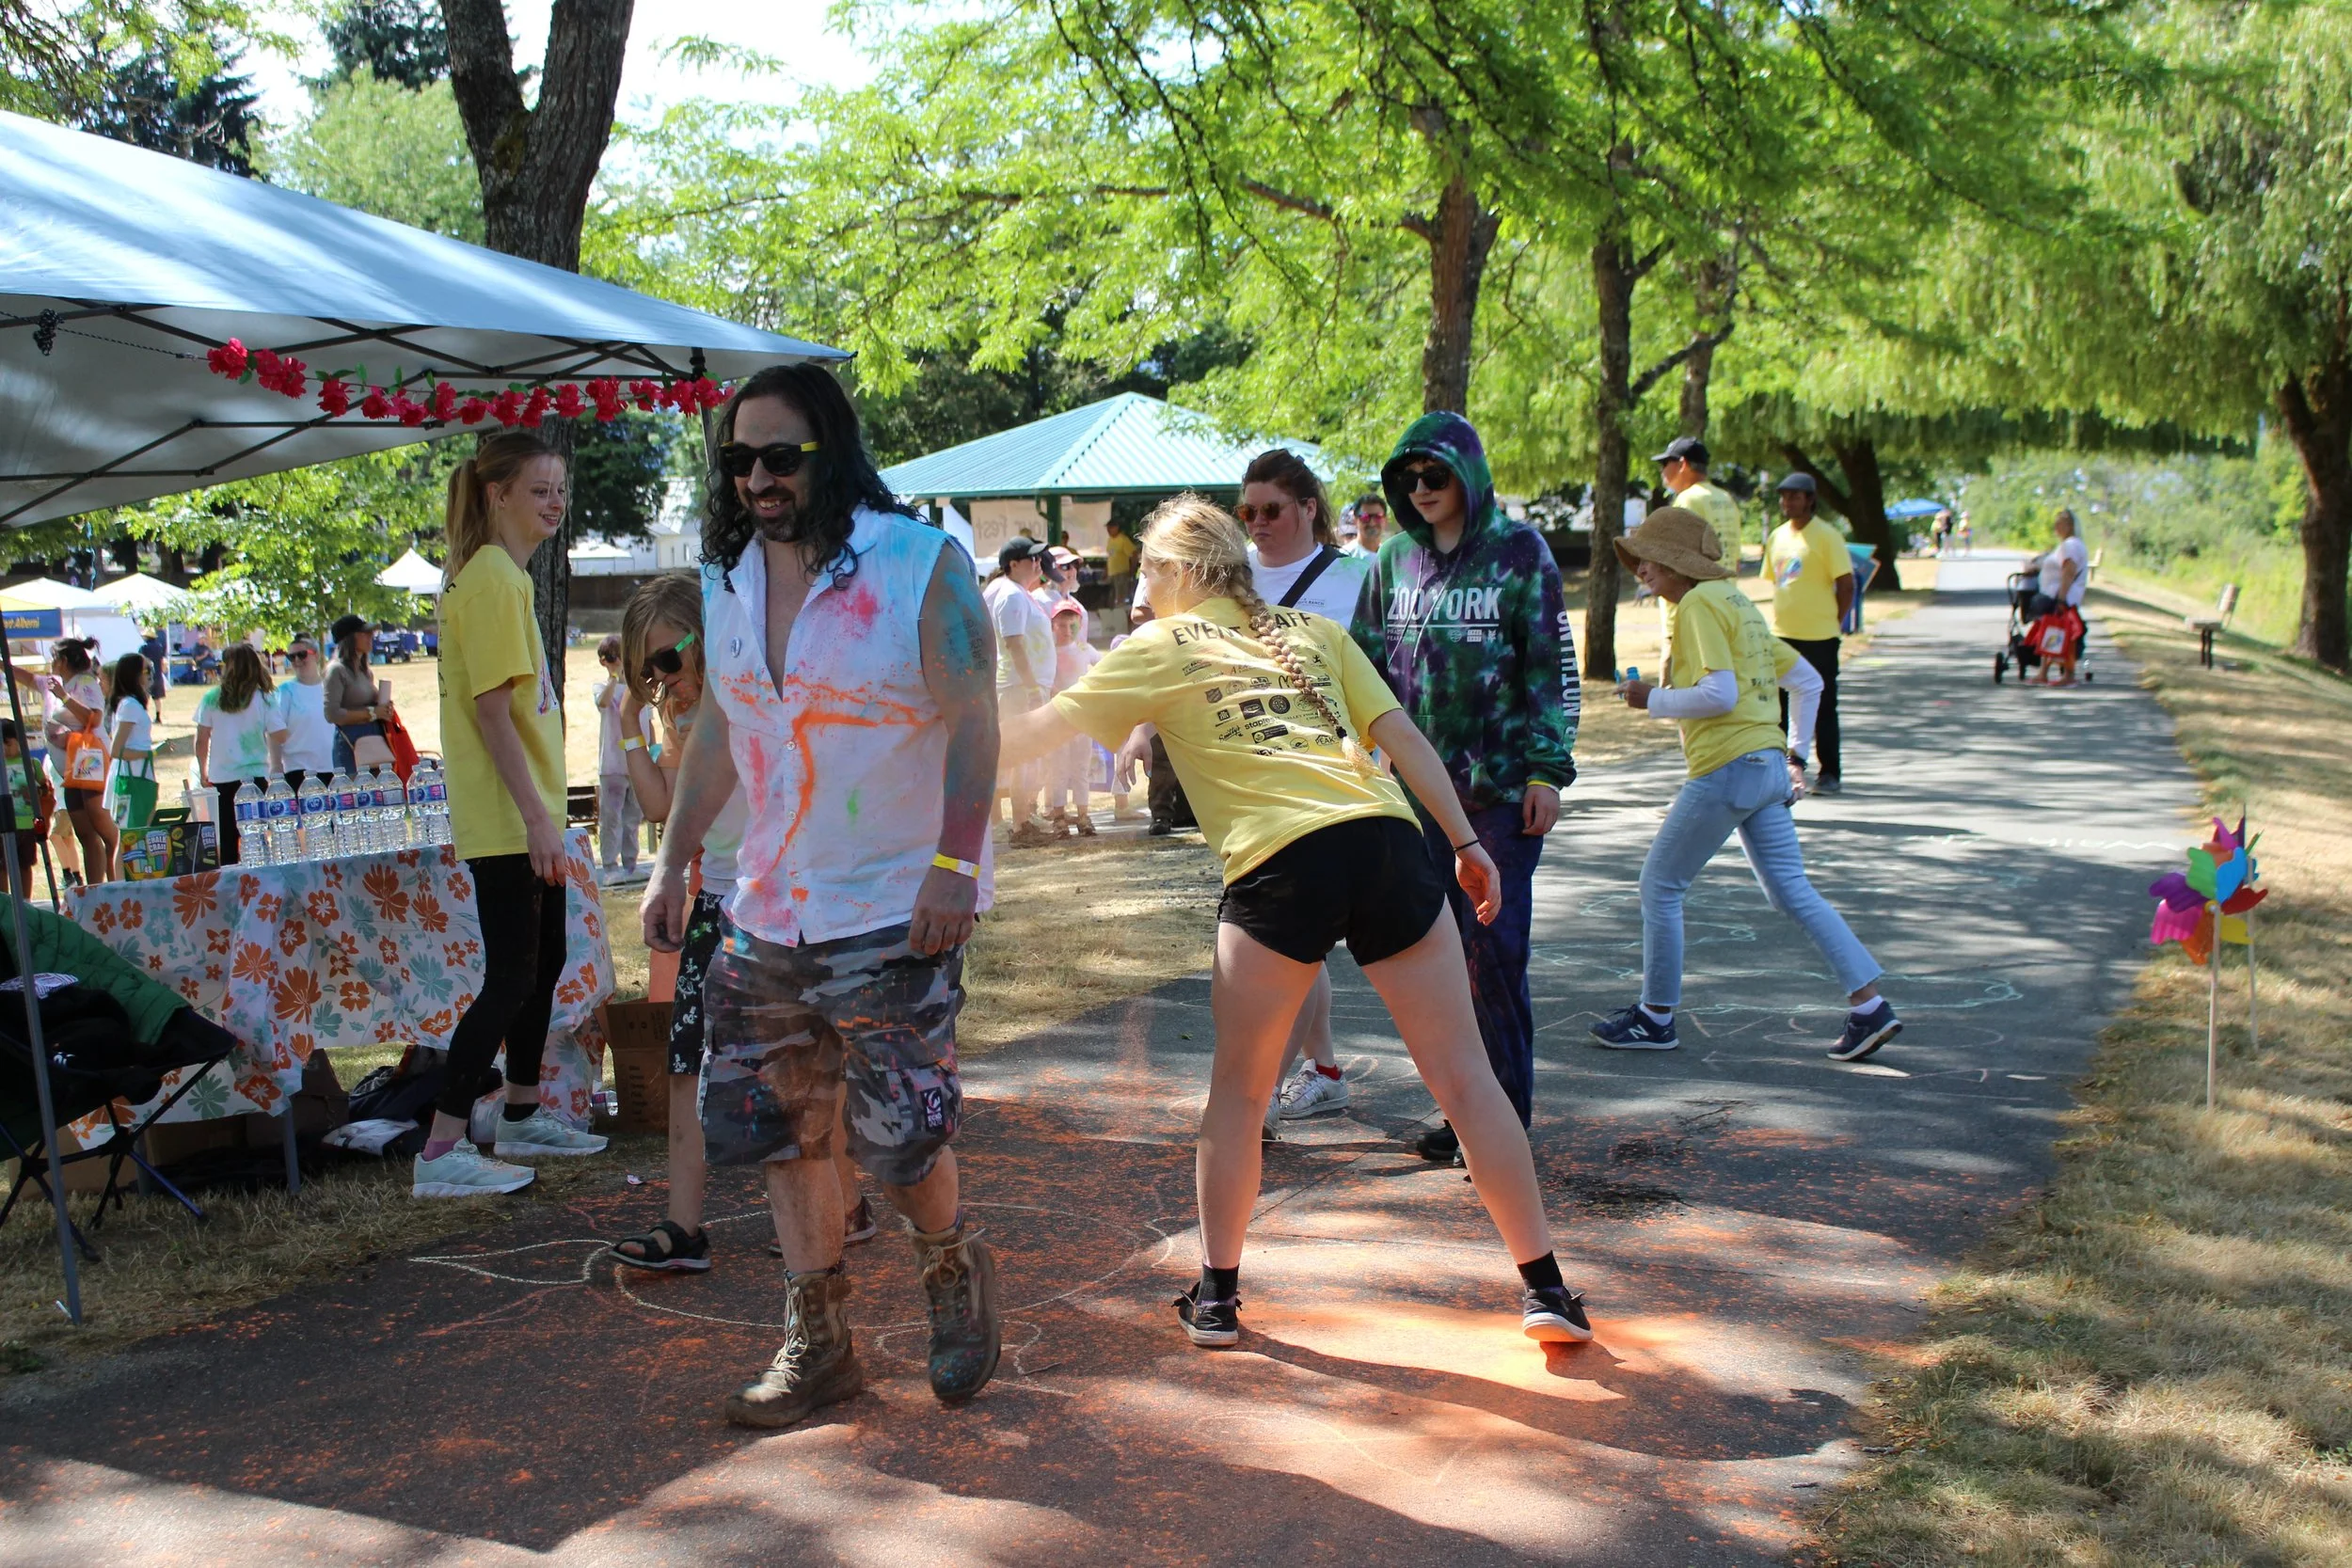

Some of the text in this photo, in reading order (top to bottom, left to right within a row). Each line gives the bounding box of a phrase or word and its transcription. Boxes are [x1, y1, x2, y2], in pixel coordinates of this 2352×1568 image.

[1387, 586, 1502, 621] ZOO YORK
[1172, 622, 1243, 646] EVENT
